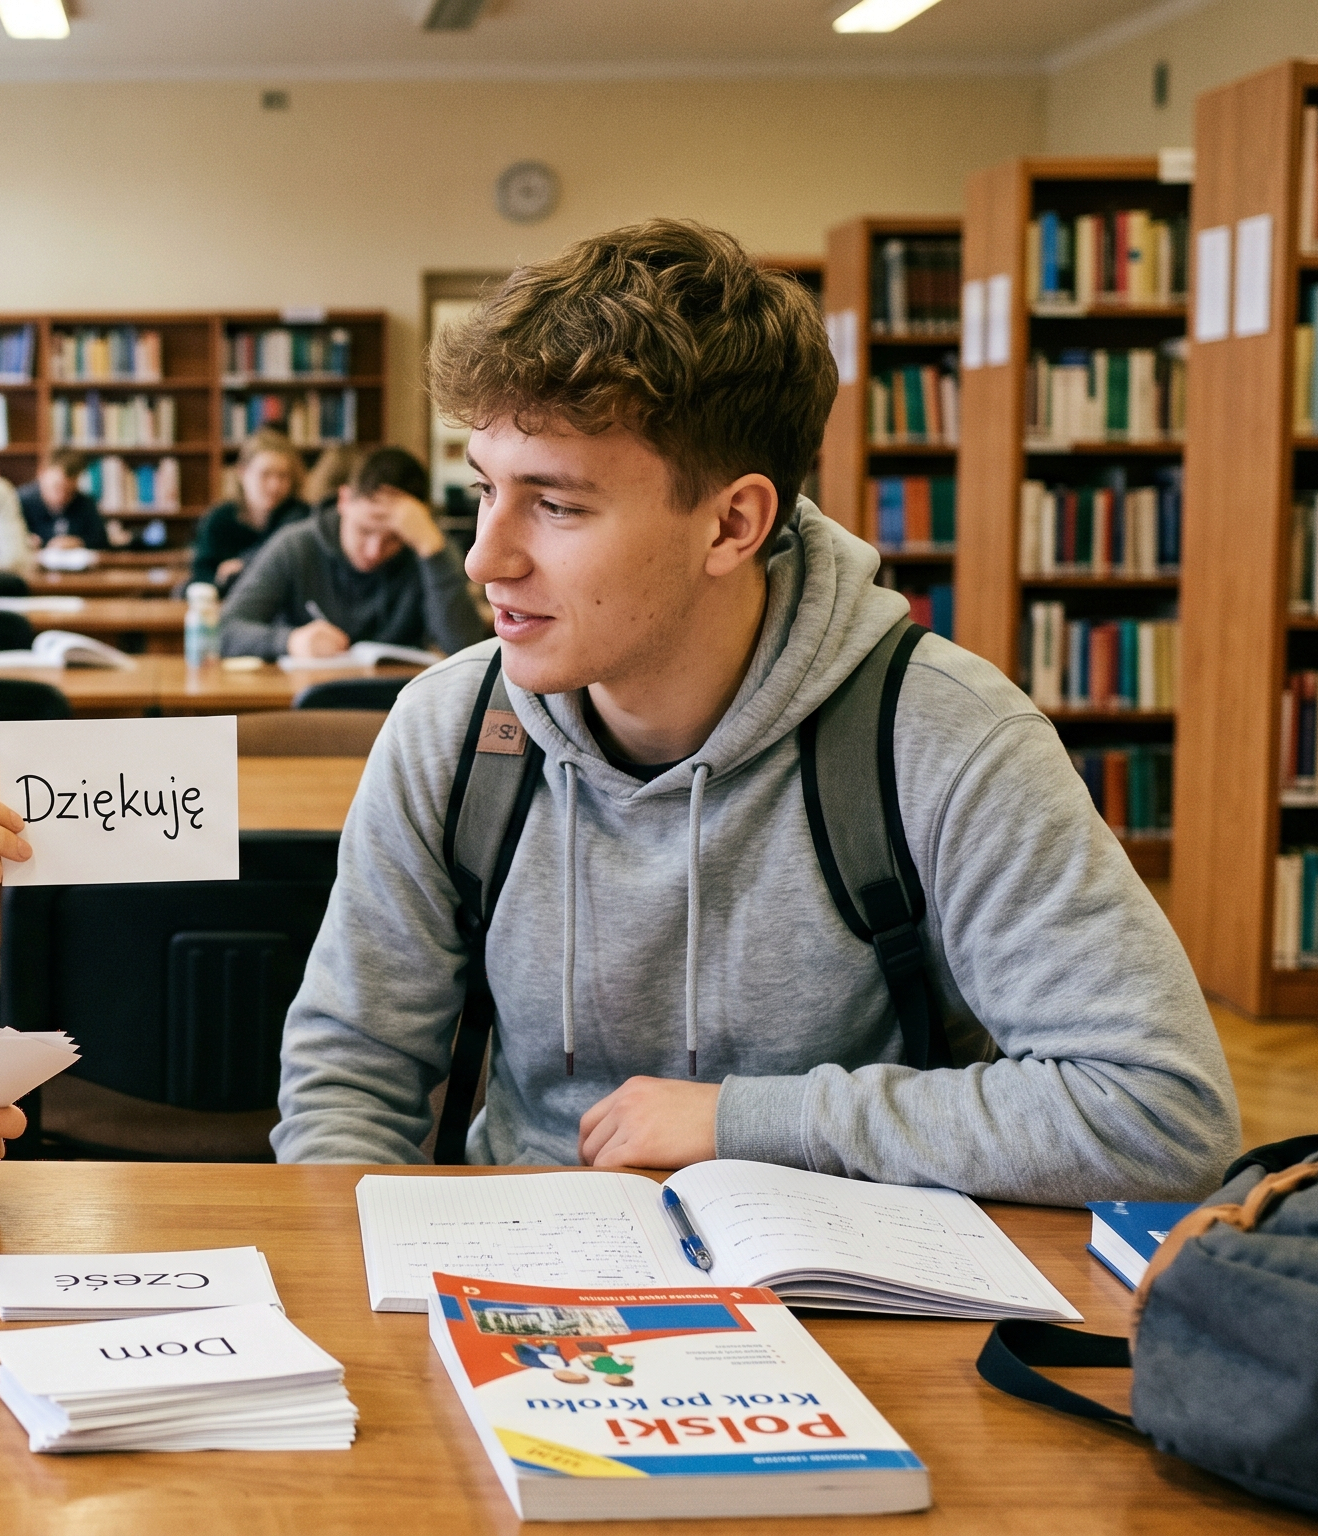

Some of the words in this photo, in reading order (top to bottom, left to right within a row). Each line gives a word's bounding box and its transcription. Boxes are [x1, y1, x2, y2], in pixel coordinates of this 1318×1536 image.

[15, 772, 204, 840] Dziękuję
[99, 1337, 237, 1361] Dom
[525, 1396, 649, 1414] Kroku
[660, 1392, 713, 1409] po
[726, 1391, 821, 1407] Krok
[605, 1413, 848, 1446] Polski
